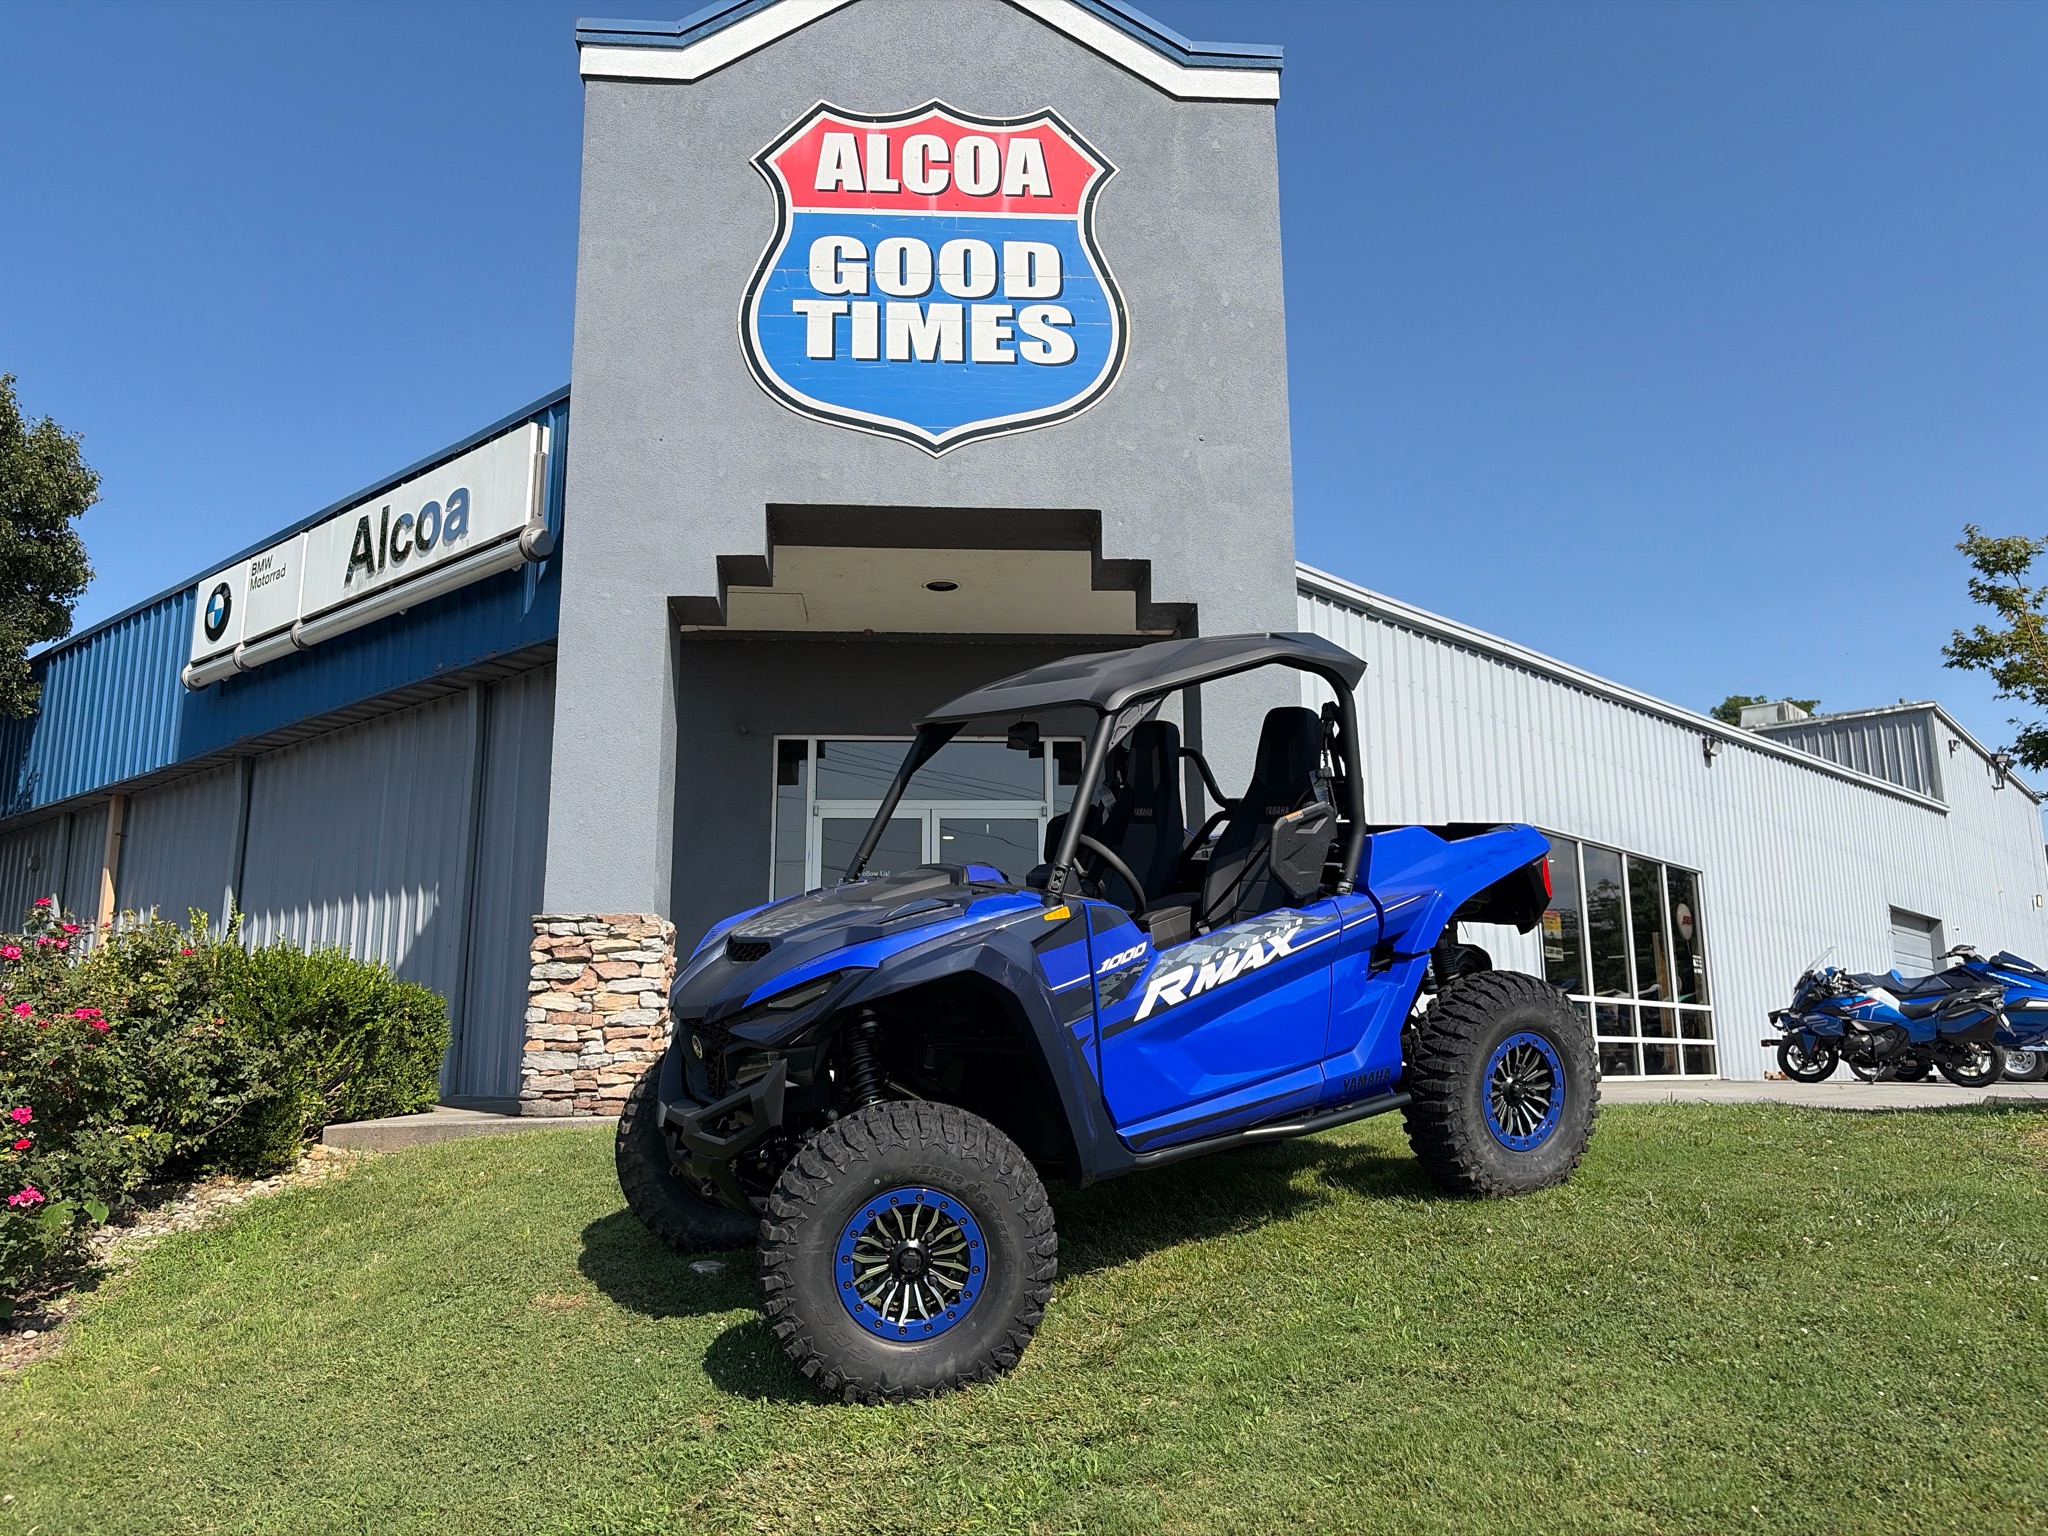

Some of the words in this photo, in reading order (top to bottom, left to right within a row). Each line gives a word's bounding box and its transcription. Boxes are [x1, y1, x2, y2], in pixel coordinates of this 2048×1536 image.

[813, 132, 1053, 198] ALCOA
[808, 235, 1063, 299] GOOD
[792, 300, 1078, 366] TIMES
[343, 487, 471, 588] Alcoa
[249, 562, 287, 592] Motorrad
[251, 554, 274, 577] BMW
[1133, 807, 1153, 817] YAMAHA
[1265, 805, 1290, 816] YAMAHA
[862, 870, 880, 878] ollow
[1096, 941, 1148, 974] 1000
[1133, 925, 1301, 1022] RMAX
[1342, 1066, 1391, 1093] YAMAHA
